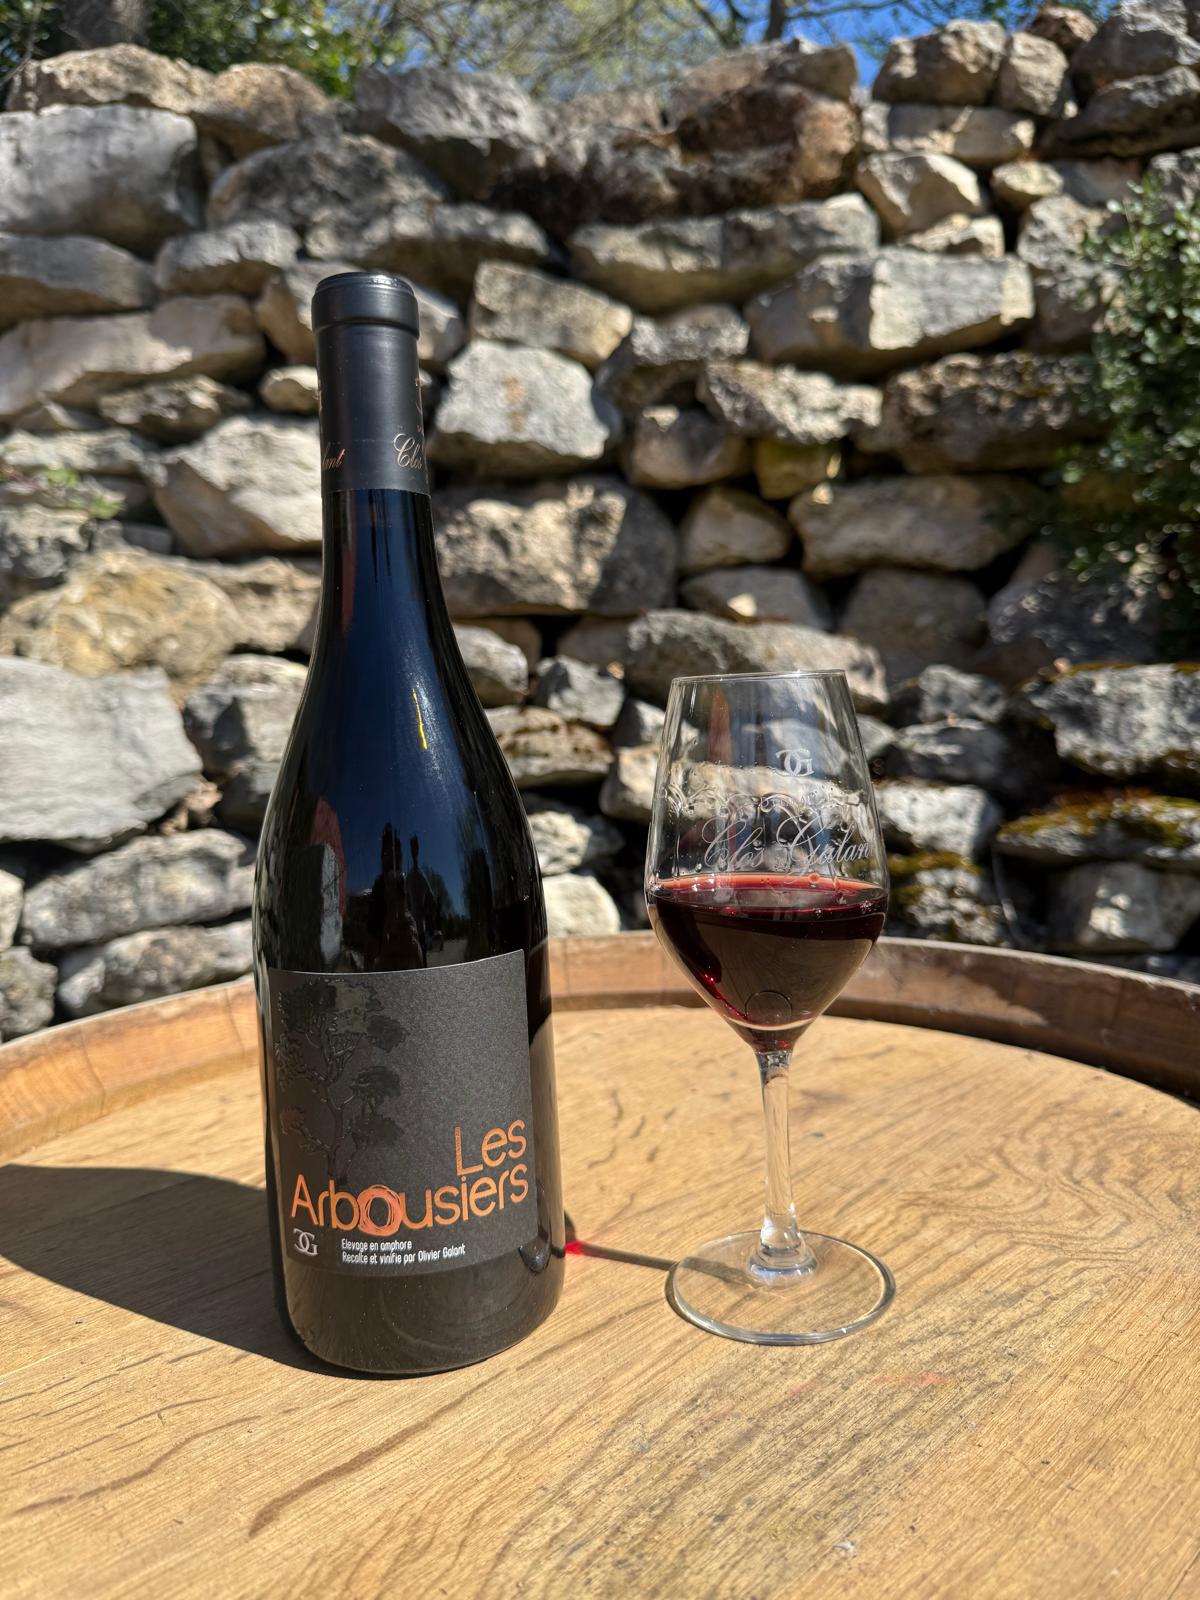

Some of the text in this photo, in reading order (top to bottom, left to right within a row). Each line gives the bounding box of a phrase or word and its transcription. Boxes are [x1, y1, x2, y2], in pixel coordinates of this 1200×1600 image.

[701, 812, 870, 884] Clos Galan
[454, 1119, 528, 1177] Les
[291, 1163, 530, 1237] Arbousiers
[369, 1241, 379, 1251] en
[380, 1239, 413, 1254] amphore
[369, 1252, 378, 1264] et
[403, 1253, 416, 1267] par
[417, 1249, 441, 1263] Olivier
[442, 1243, 466, 1259] Galant
